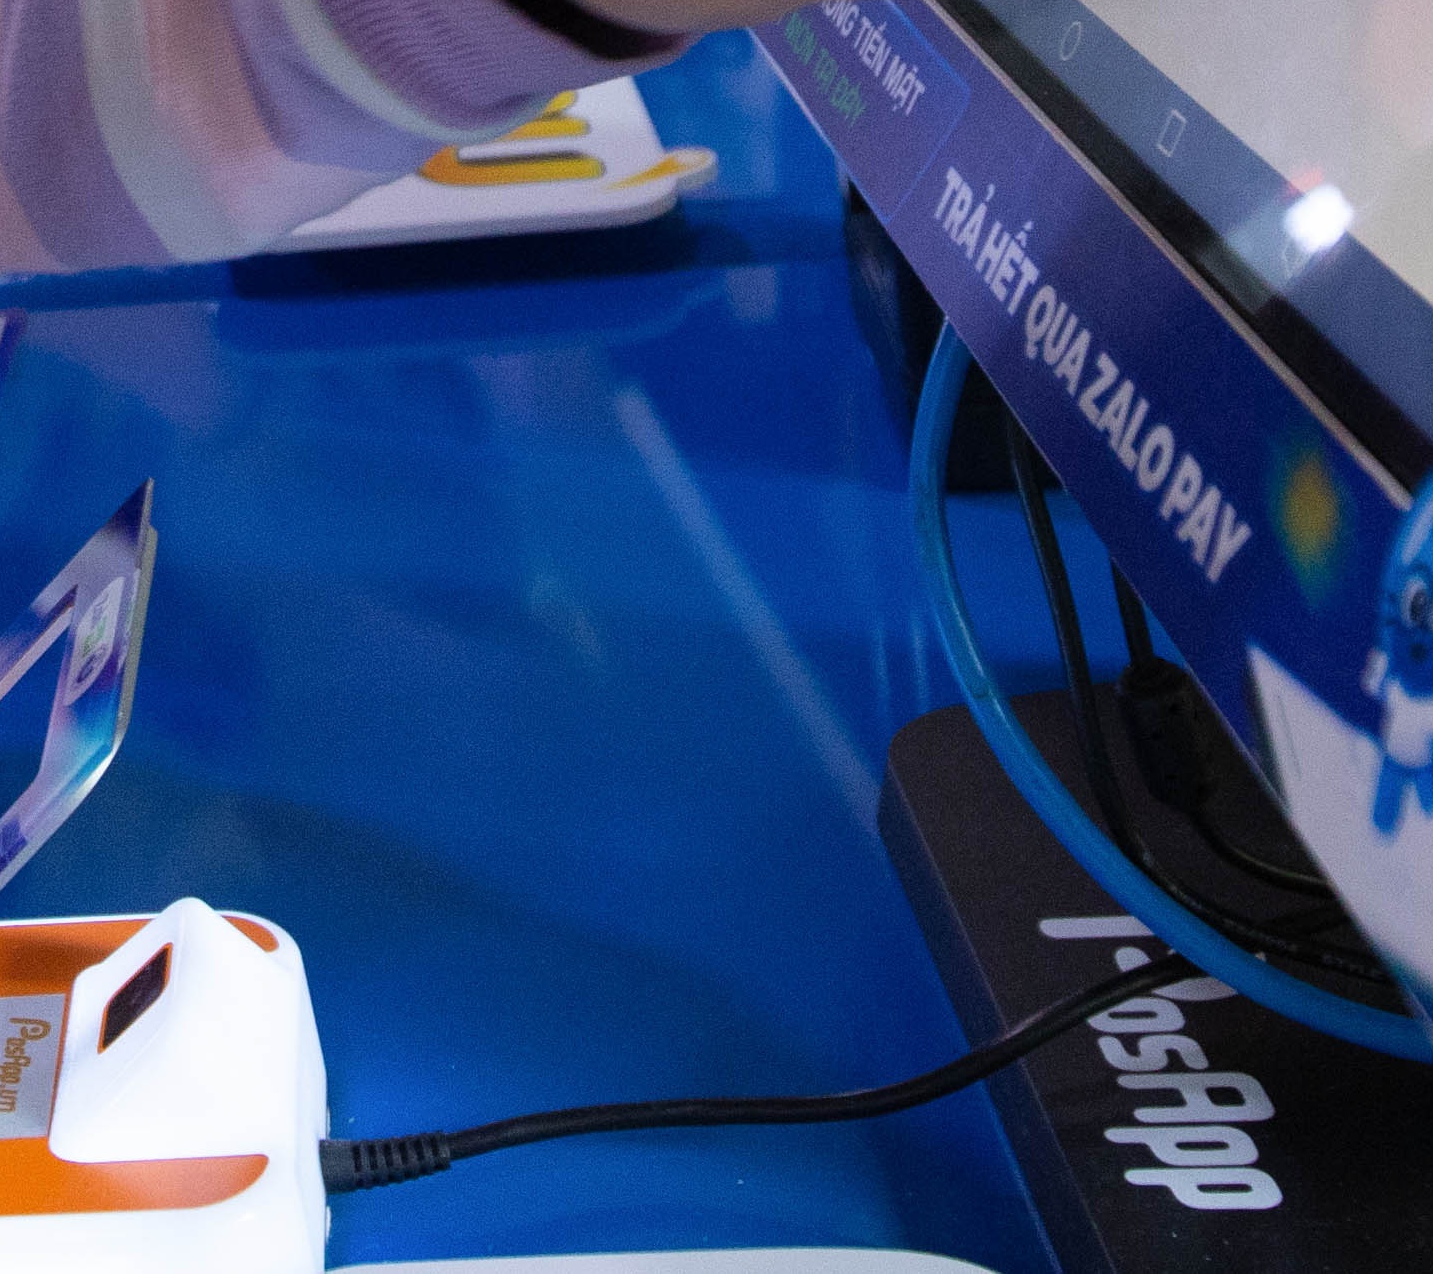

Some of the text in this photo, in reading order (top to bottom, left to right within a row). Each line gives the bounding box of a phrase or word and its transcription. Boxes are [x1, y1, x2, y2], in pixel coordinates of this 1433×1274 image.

[934, 166, 1252, 583] TRẢ HẾT QUA ZALO PAY
